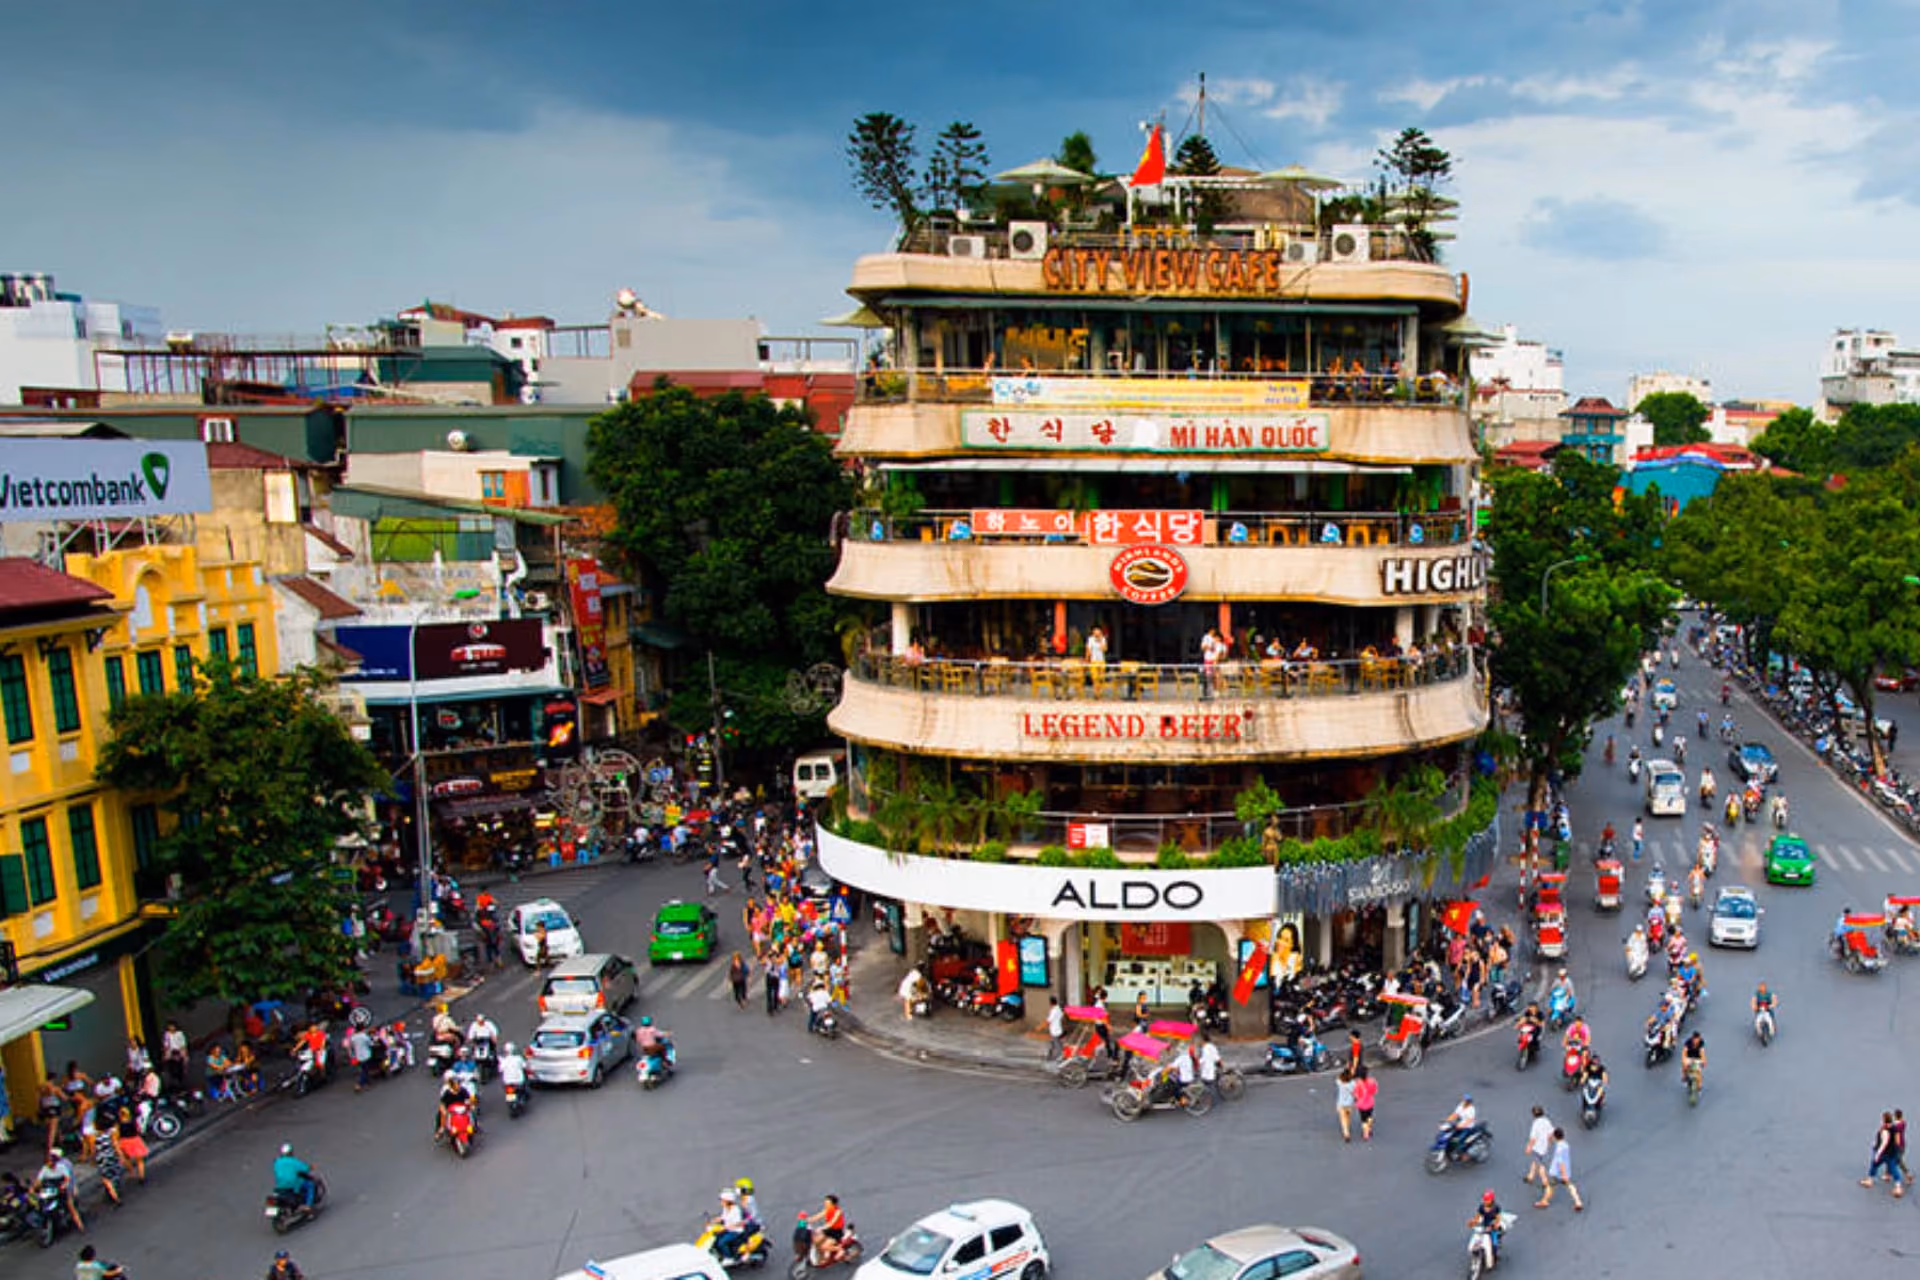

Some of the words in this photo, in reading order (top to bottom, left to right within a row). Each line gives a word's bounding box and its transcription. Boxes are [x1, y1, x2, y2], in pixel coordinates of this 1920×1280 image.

[1042, 248, 1111, 290] CITY
[1120, 248, 1199, 290] VIEW
[1205, 248, 1280, 290] CAFE
[1024, 713, 1145, 737] LEGEND
[1159, 713, 1241, 737] BEER
[1051, 879, 1204, 910] ALDO
